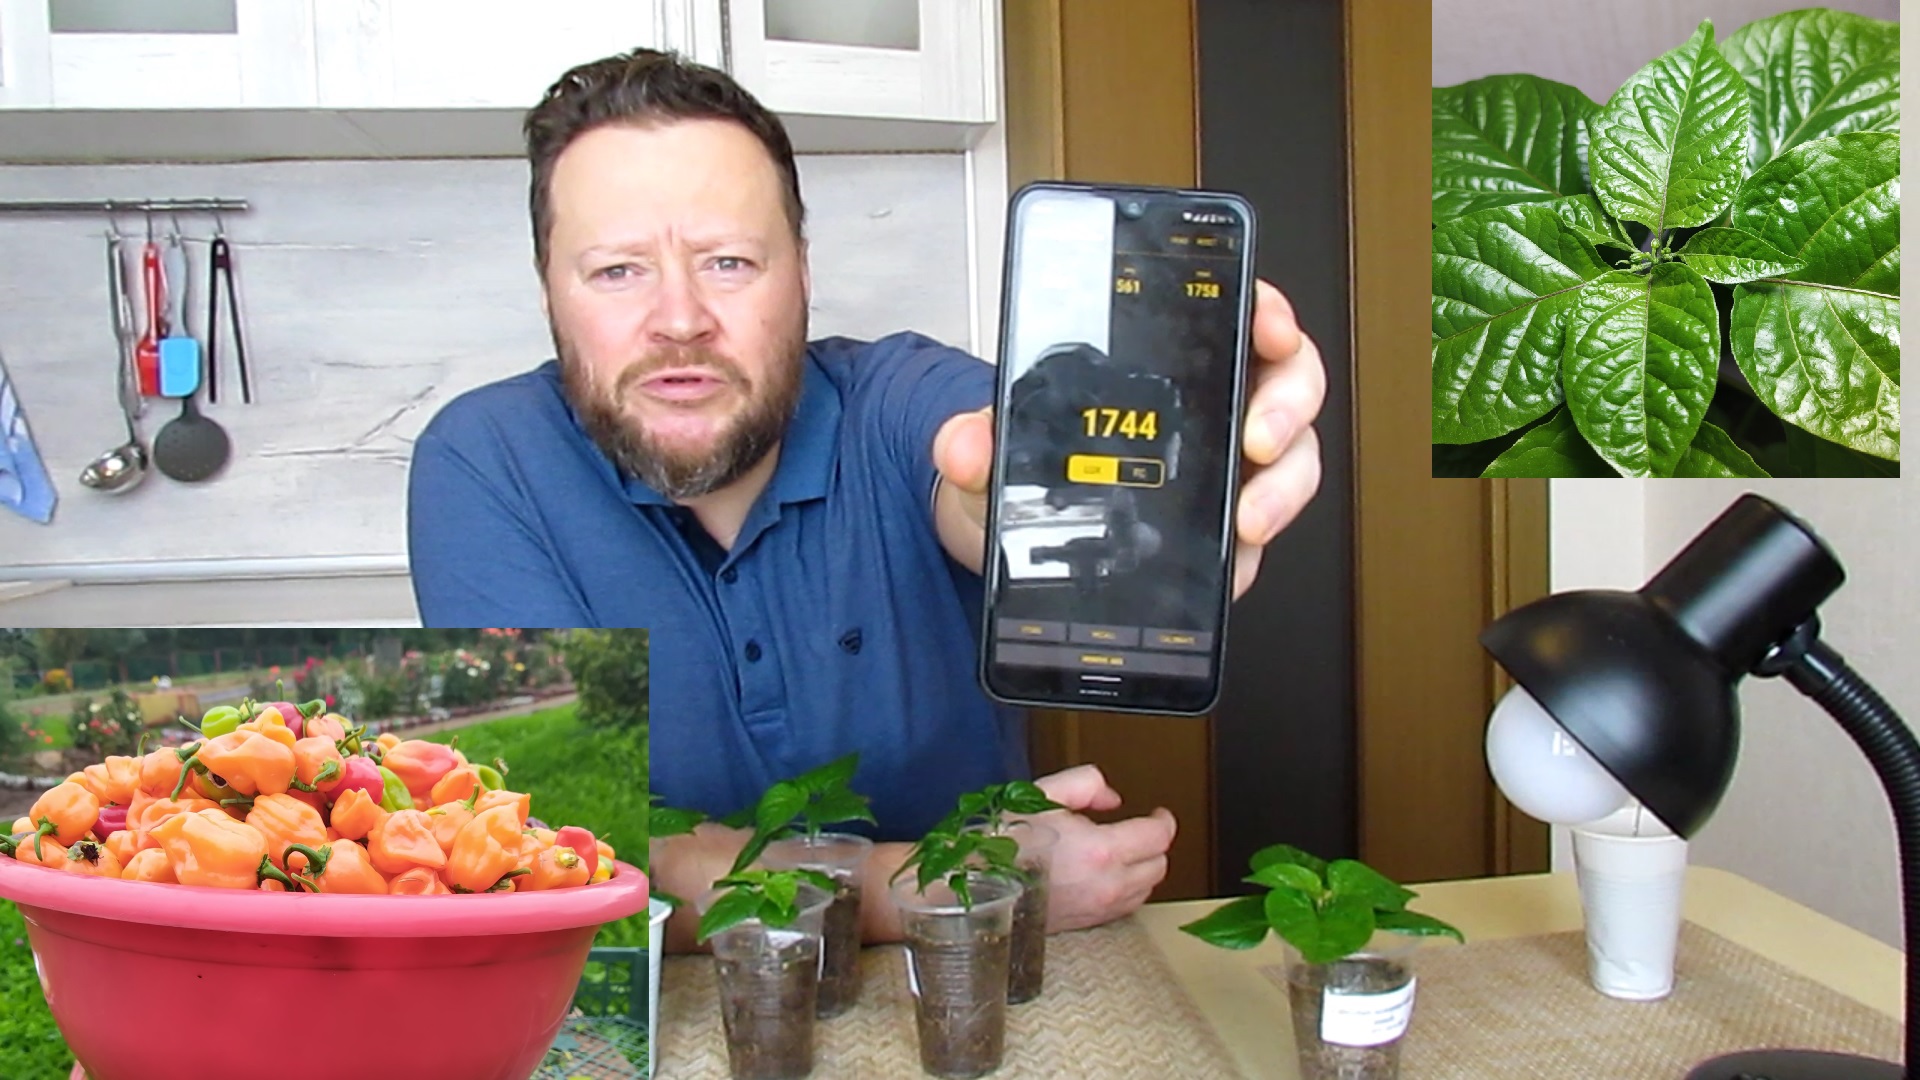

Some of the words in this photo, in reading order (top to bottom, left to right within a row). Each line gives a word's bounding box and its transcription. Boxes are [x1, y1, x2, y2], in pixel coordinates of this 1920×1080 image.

[1116, 278, 1140, 294] 561
[1185, 282, 1219, 298] 1758
[1083, 408, 1157, 440] 1744
